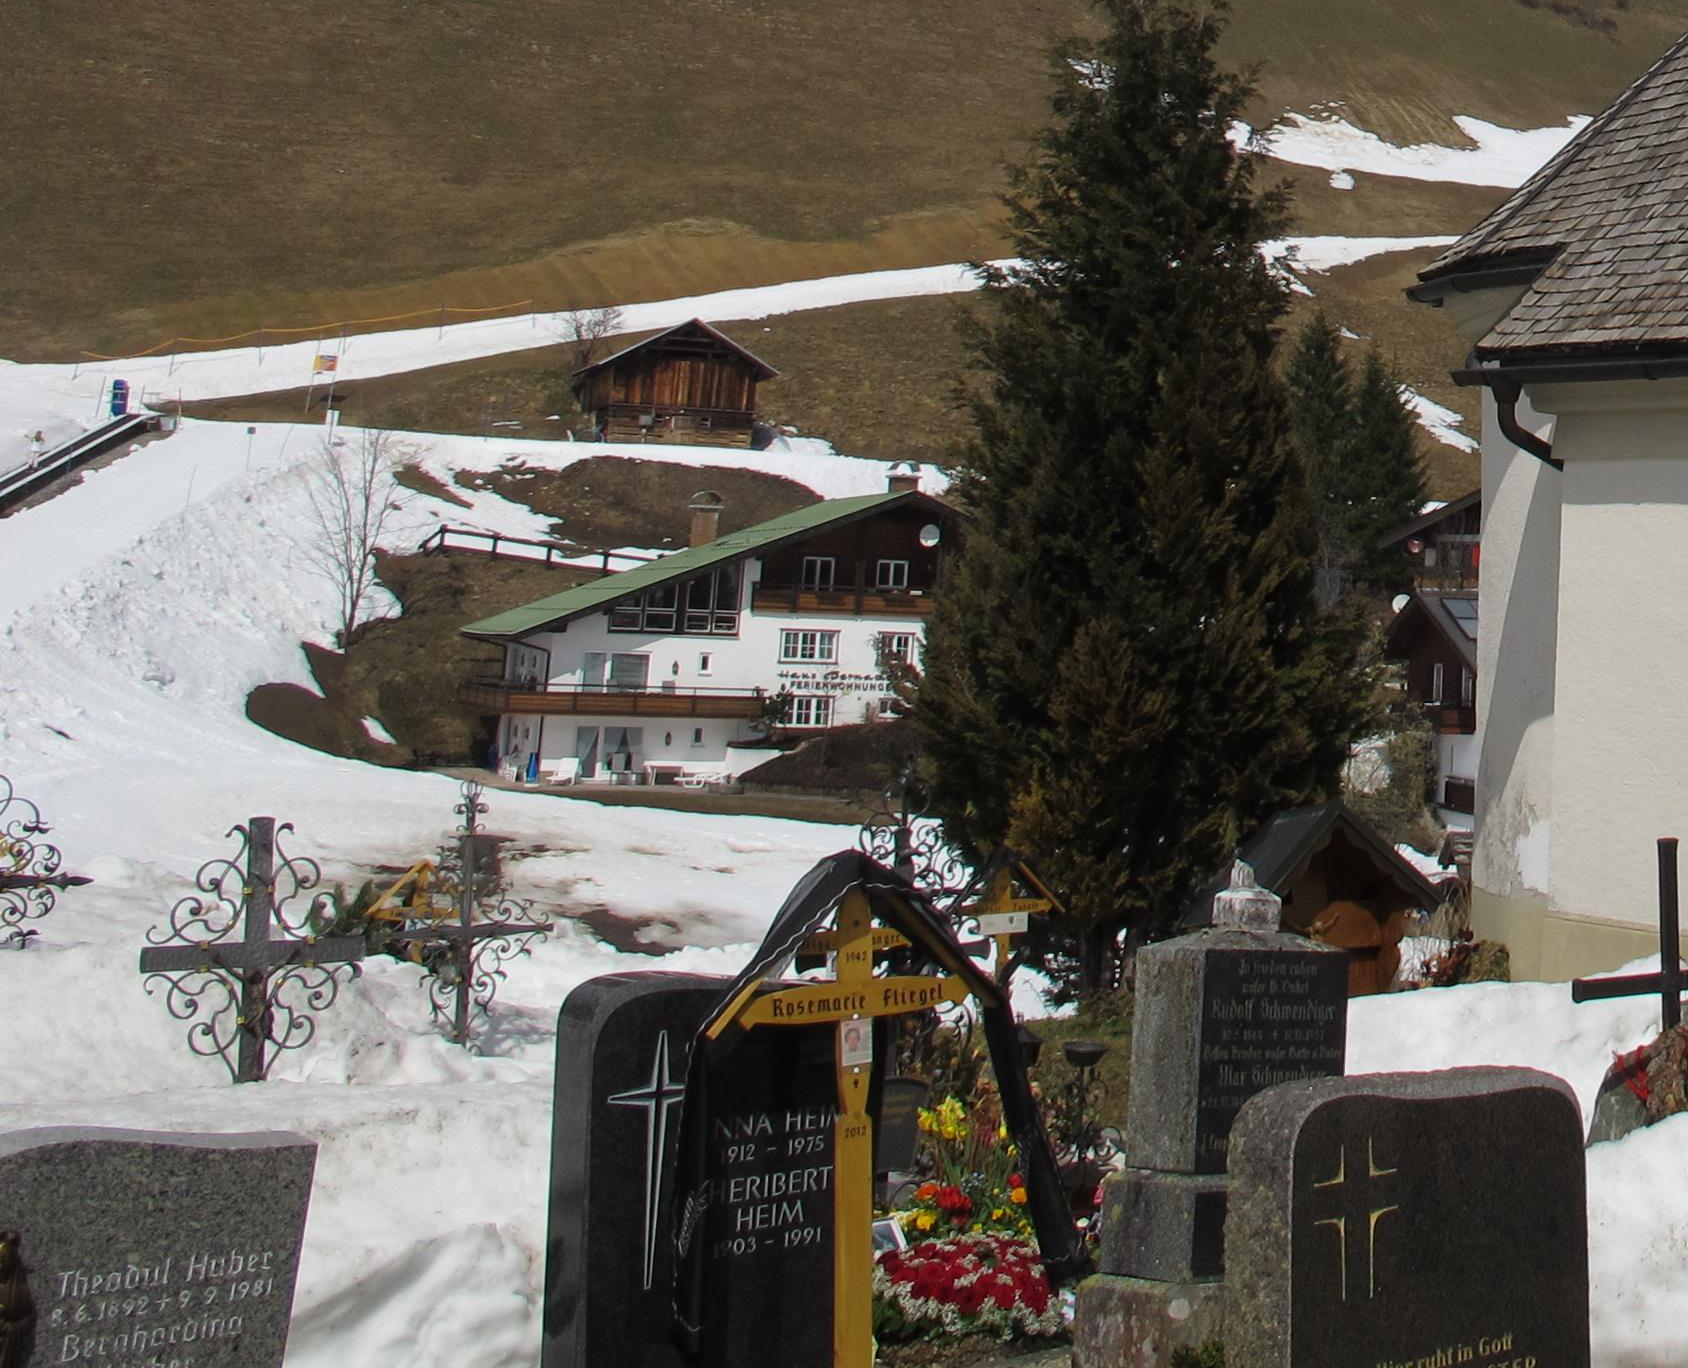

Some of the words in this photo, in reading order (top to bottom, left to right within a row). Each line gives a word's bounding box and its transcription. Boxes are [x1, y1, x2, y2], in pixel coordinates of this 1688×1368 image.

[790, 680, 890, 692] FERIENWOHNUNGE
[845, 950, 867, 963] 1942
[772, 992, 866, 1018] Rosemarie
[883, 984, 944, 1007] Fliegel
[1211, 998, 1255, 1020] Rudolf
[713, 1112, 773, 1140] NNA
[844, 1125, 867, 1139] 2012
[721, 1143, 755, 1164] 1912
[788, 1135, 824, 1157] 1975
[709, 1165, 833, 1203] HERIBERT
[736, 1199, 804, 1232] HEIM
[784, 1226, 822, 1248] 1991
[58, 1256, 171, 1299] Theodul
[187, 1248, 273, 1282] Huber
[1417, 1346, 1454, 1368] ruht
[1457, 1343, 1473, 1363] in
[1479, 1331, 1514, 1357] Gott
